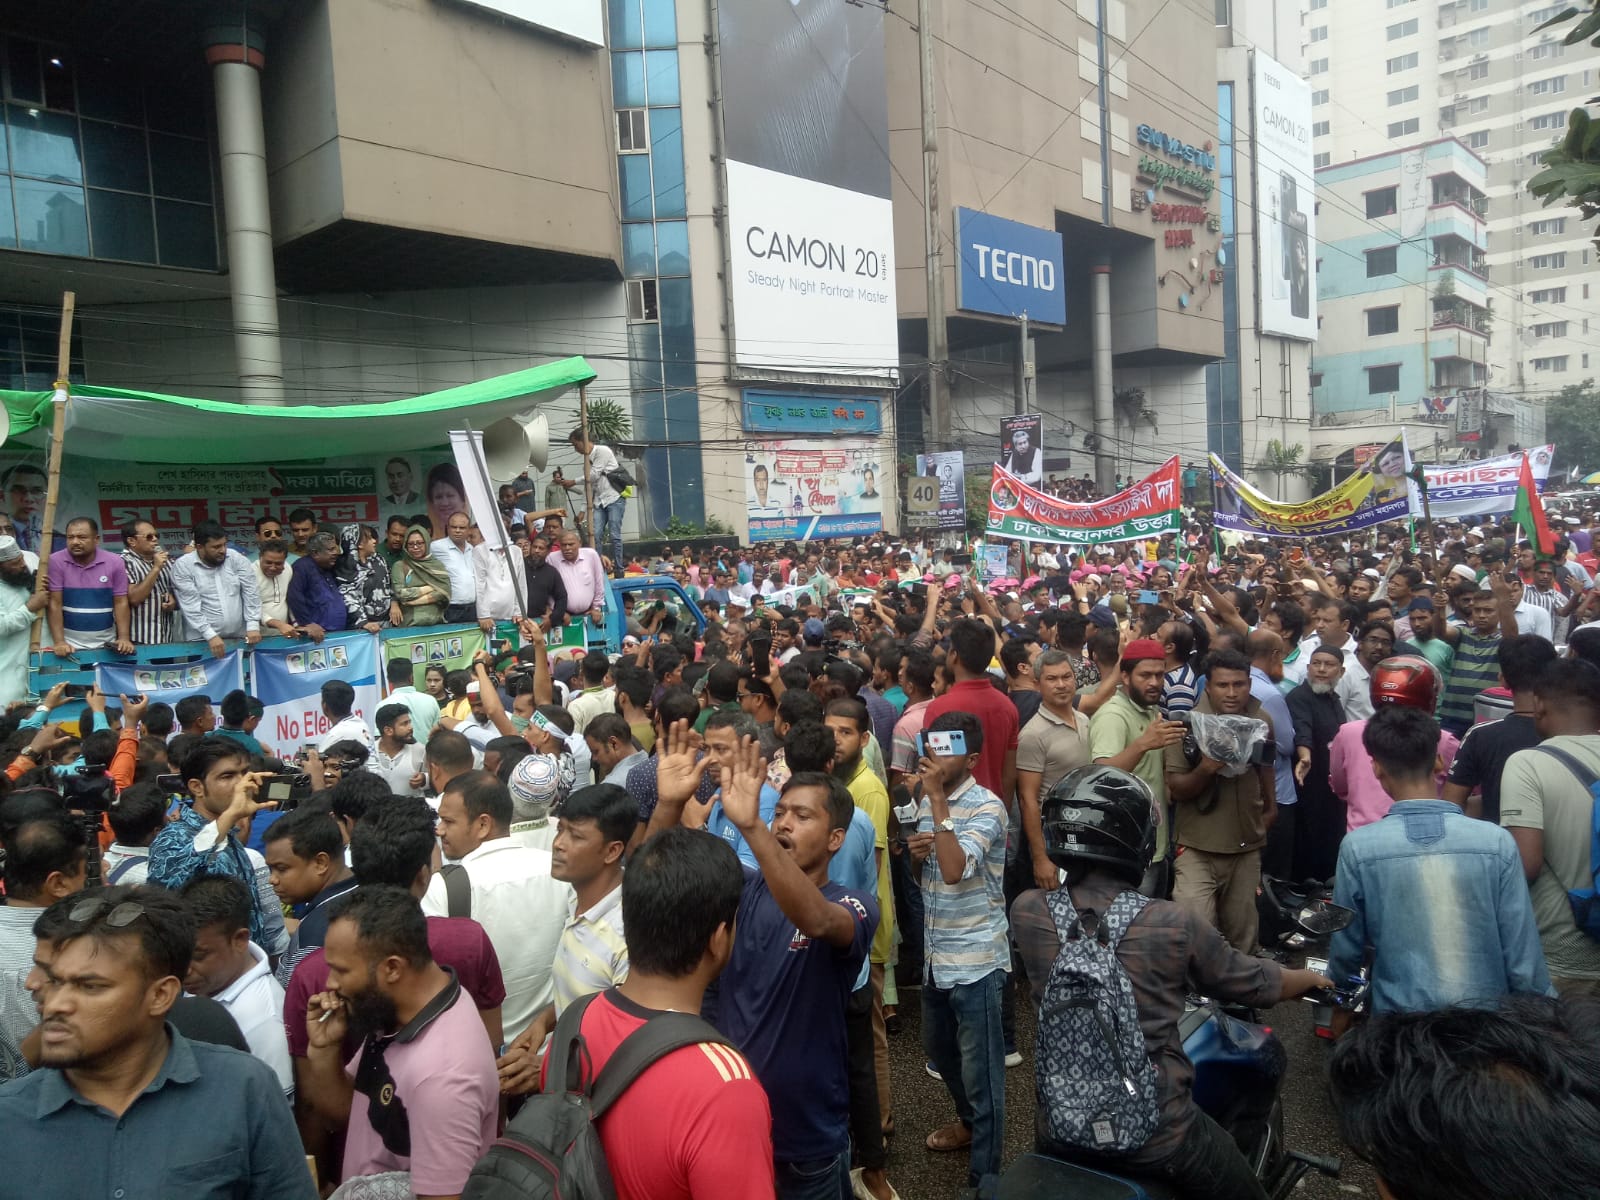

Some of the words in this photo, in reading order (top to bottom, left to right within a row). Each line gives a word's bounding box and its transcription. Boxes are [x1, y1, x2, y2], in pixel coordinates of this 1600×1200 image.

[1263, 106, 1295, 137] CAMON
[1297, 125, 1305, 143] 20
[746, 226, 845, 272] CAMON
[855, 248, 878, 278] 20
[973, 243, 1055, 291] TECNO
[748, 270, 785, 292] Steady
[789, 277, 816, 295] Night
[820, 282, 854, 298] Portrait
[858, 288, 889, 304] Master
[285, 476, 320, 489] দফা
[324, 471, 374, 489] দাবিতে
[1424, 466, 1521, 486] ণমিছিল
[913, 486, 934, 502] 40
[1012, 519, 1051, 538] ঢাকা
[1056, 522, 1126, 541] মহানগর
[1130, 512, 1173, 532] উত্তর
[276, 714, 300, 741] No
